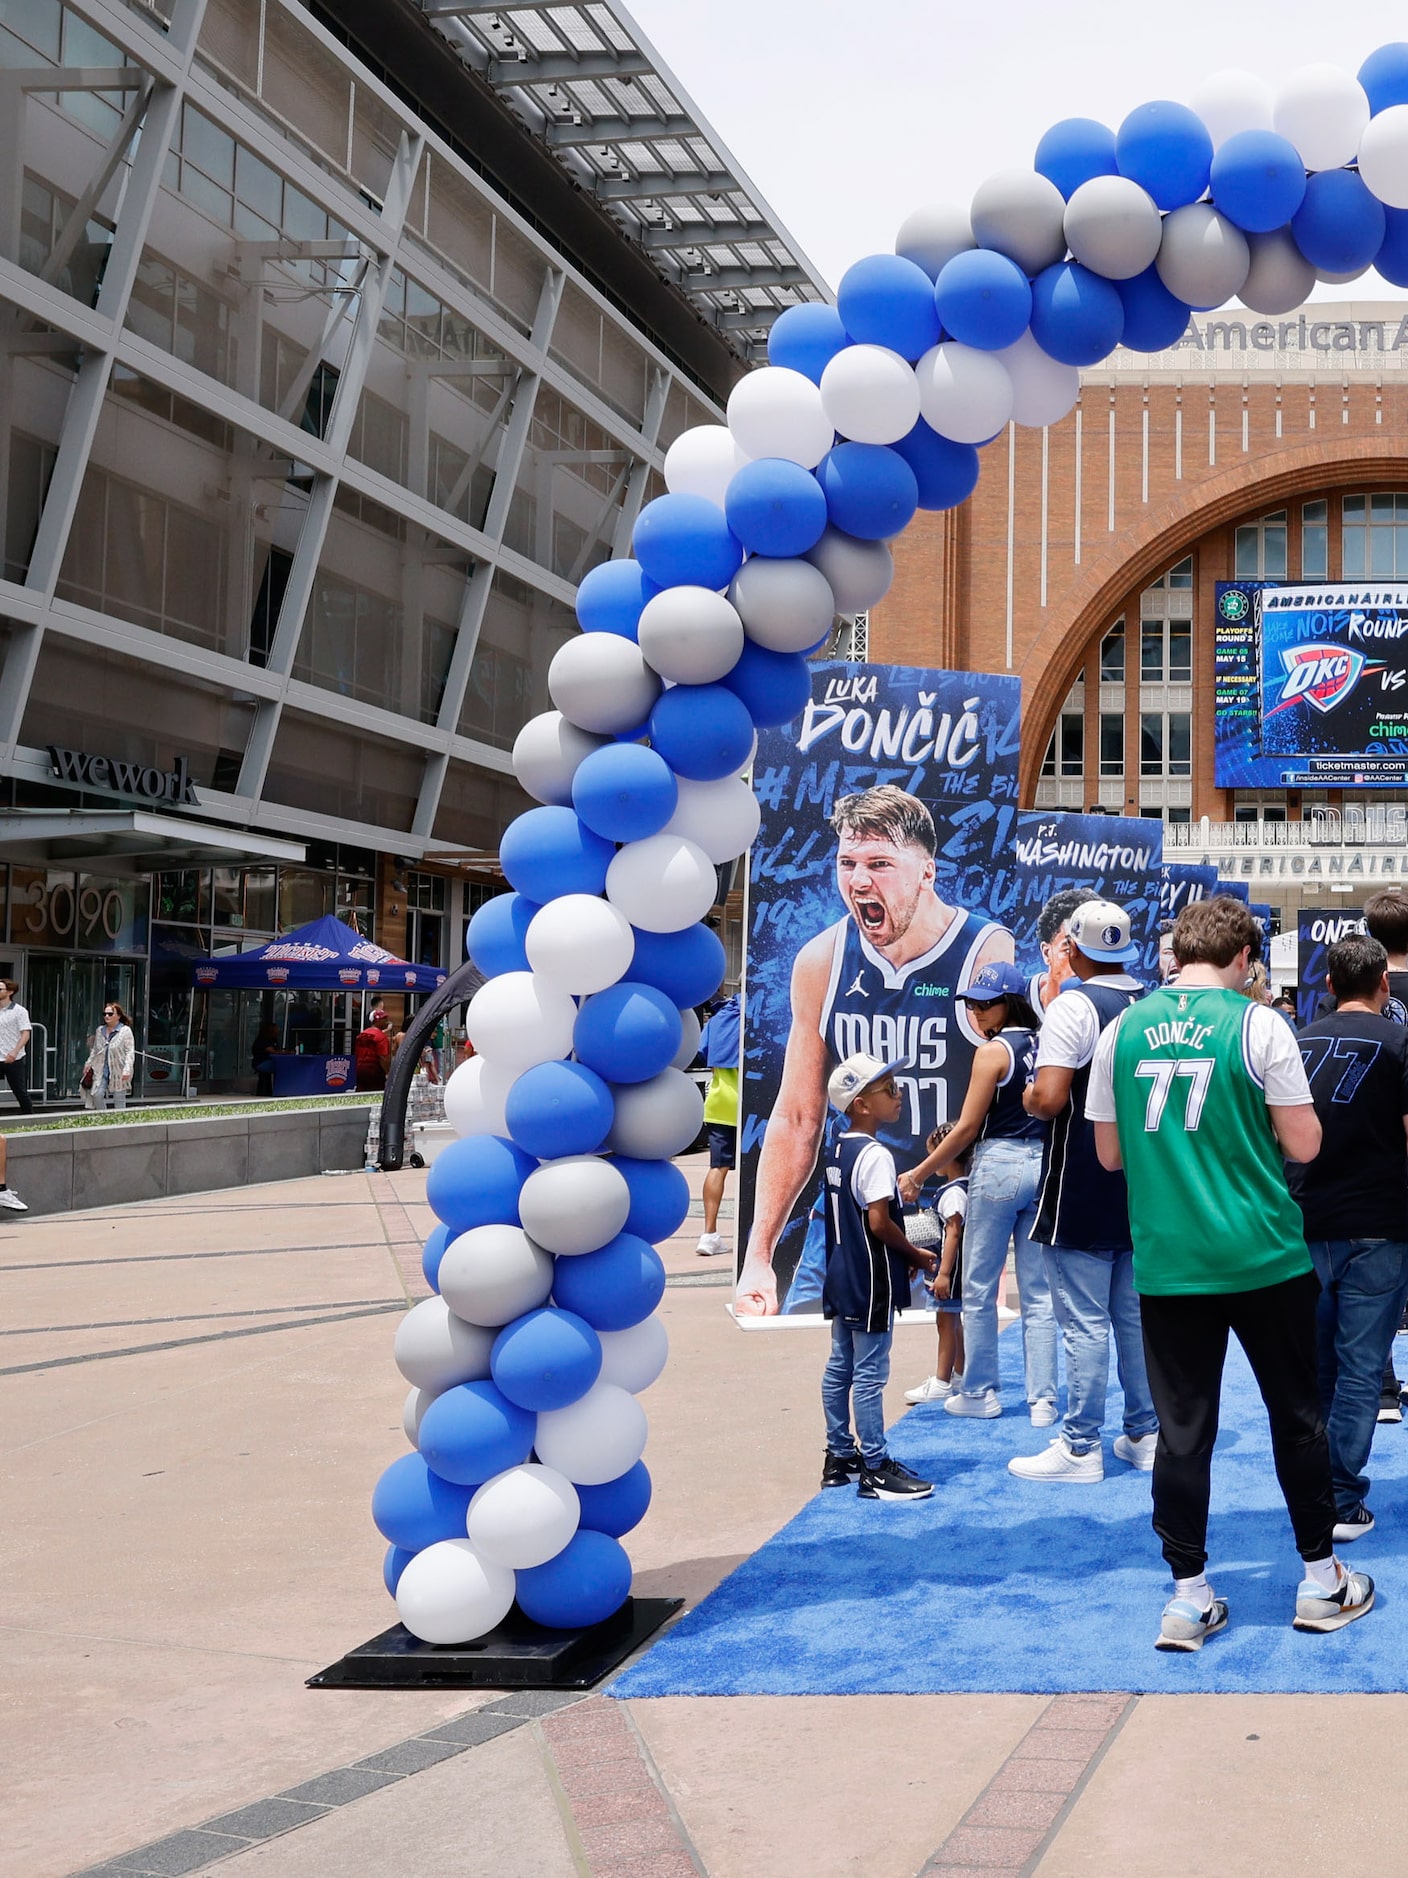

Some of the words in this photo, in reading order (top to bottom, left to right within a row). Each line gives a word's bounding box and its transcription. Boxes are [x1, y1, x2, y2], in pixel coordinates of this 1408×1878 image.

[1282, 654, 1349, 696] OKC
[1381, 669, 1408, 692] VS
[824, 676, 878, 704] LUKA
[796, 691, 980, 769] DONČIĆ
[46, 745, 202, 806] wework
[1316, 761, 1405, 770] ticketmaster.com
[1364, 774, 1403, 782] @AACenter
[940, 771, 980, 795] THE
[1037, 823, 1057, 838] P.J.
[1015, 837, 1151, 873] WASHINGTON
[1113, 879, 1138, 895] THE
[25, 880, 123, 940] 3090
[1311, 916, 1358, 945] ONE
[914, 983, 950, 997] chime
[1143, 1016, 1215, 1051] DONČIĆ
[894, 1076, 948, 1136] 77
[1134, 1058, 1216, 1132] 77
